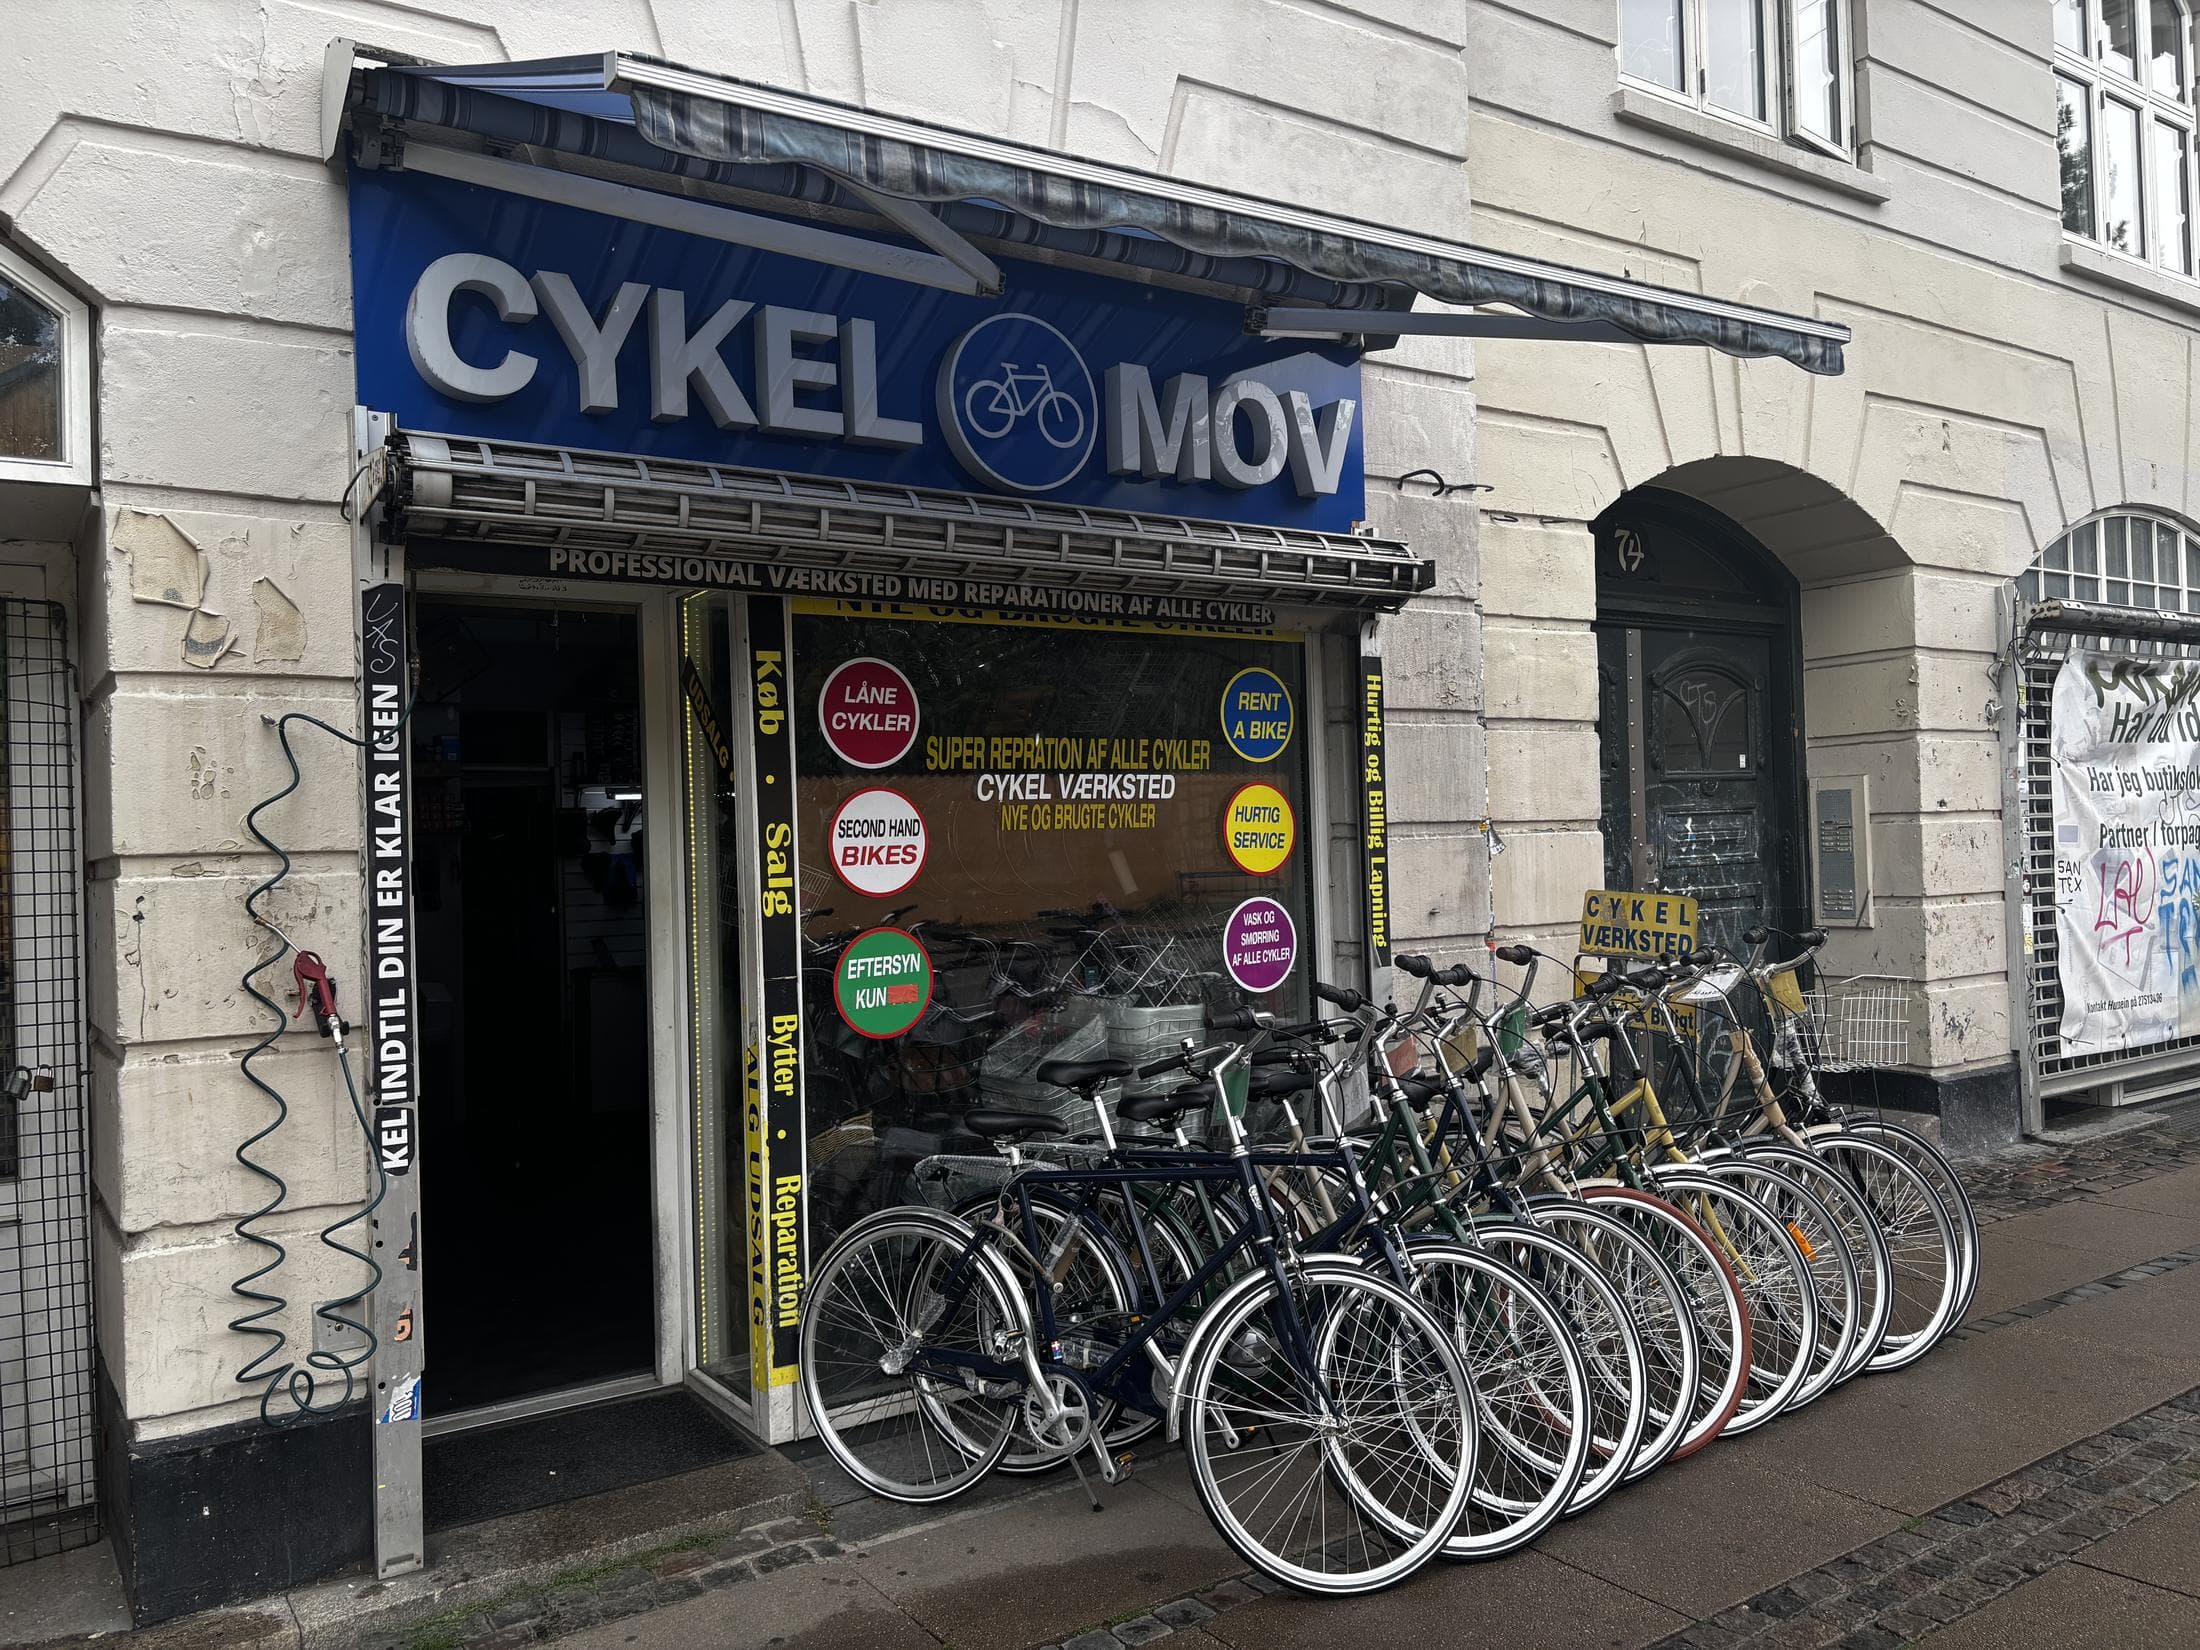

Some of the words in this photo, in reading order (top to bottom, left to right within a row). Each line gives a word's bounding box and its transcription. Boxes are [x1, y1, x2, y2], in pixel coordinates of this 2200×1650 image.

[406, 251, 923, 450] CYKEL
[1104, 360, 1358, 499] MOV
[1614, 528, 1645, 573] 74
[549, 547, 762, 587] PROFESSIONAL
[768, 564, 901, 598] VÆRKSTED
[908, 576, 959, 602] MED
[964, 581, 1123, 616] REPARATIONER
[1127, 595, 1153, 617] AF
[1157, 598, 1201, 619] ALLE
[1206, 601, 1274, 623] CYKLER
[755, 650, 785, 735] Køb
[844, 680, 897, 705] LÅNE
[1238, 691, 1282, 711] RENT
[371, 684, 400, 761] IGEN
[688, 673, 729, 769] UDSALG
[832, 712, 911, 732] CYKLER
[1364, 674, 1382, 747] Hurtig
[2109, 702, 2153, 743] Har
[1233, 720, 1245, 739] A
[1249, 721, 1287, 739] BIKE
[926, 735, 985, 771] SUPER
[990, 737, 1083, 770] REPRATION
[1086, 739, 1107, 770] AF
[1110, 739, 1149, 770] ALLE
[1152, 740, 1211, 770] CYKLER
[1366, 754, 1381, 782] og
[977, 774, 1051, 801] CYKEL
[1058, 774, 1176, 800] VÆRKSTED
[2087, 766, 2115, 792] Har
[2115, 766, 2142, 798] jeg
[374, 771, 402, 858] KLAR
[838, 819, 885, 838] SECOND
[889, 818, 920, 837] HAND
[1001, 804, 1028, 831] NYE
[1031, 804, 1051, 831] OG
[1054, 804, 1105, 830] BRUGTE
[1108, 803, 1156, 829] CYKLER
[1235, 806, 1280, 823] HURTIG
[1368, 790, 1384, 850] Billig
[1234, 832, 1285, 849] SERVICE
[2099, 823, 2148, 849] Partner
[762, 822, 792, 918] Salg
[841, 844, 917, 866] BIKES
[2058, 860, 2081, 876] SAN
[377, 867, 403, 906] ER
[1369, 857, 1387, 948] Lapning
[1243, 911, 1262, 926] VASK
[1263, 910, 1275, 924] OG
[1586, 896, 1691, 926] CYKEL
[377, 918, 405, 979] DIN
[1583, 924, 1693, 956] VÆRKSTED
[847, 953, 921, 979] EFTERSYN
[1232, 953, 1242, 967] AF
[1243, 951, 1261, 965] ALLE
[1262, 947, 1290, 962] CYKLER
[856, 987, 887, 1009] KUN
[379, 988, 408, 1101] INDTIL
[767, 1014, 799, 1097] Bytter
[748, 1150, 764, 1326] UDSALG
[775, 1174, 802, 1329] Reparation
